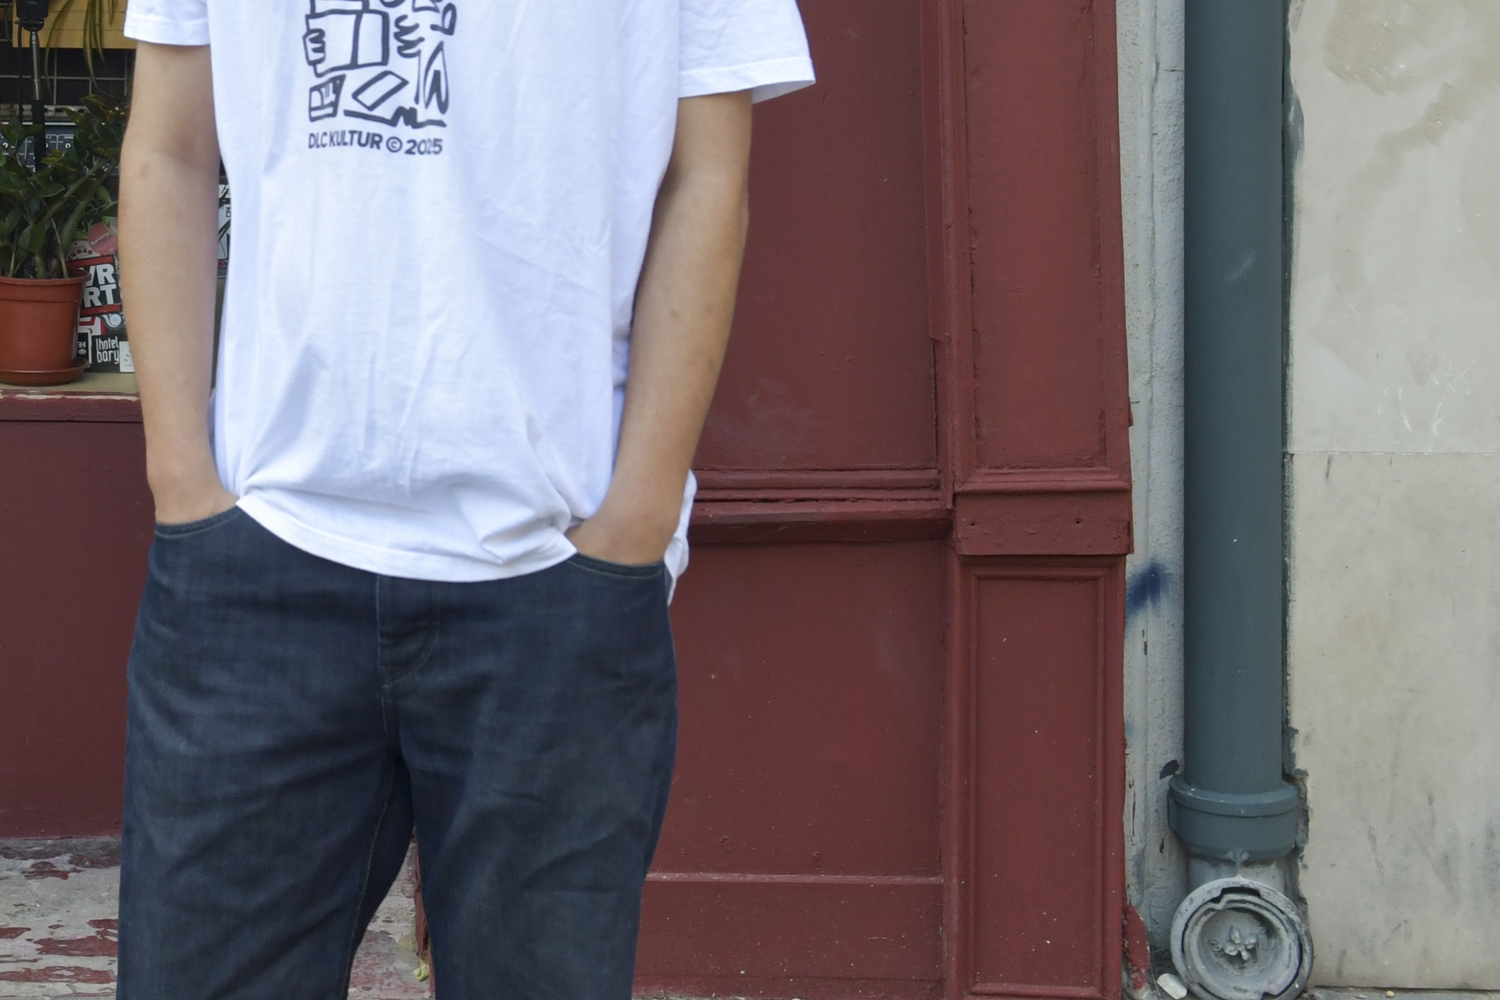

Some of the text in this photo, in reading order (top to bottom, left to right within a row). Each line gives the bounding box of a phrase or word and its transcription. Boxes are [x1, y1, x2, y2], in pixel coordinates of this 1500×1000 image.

[308, 132, 328, 149] DLC
[329, 130, 383, 150] KULTUR
[404, 138, 443, 155] 2025
